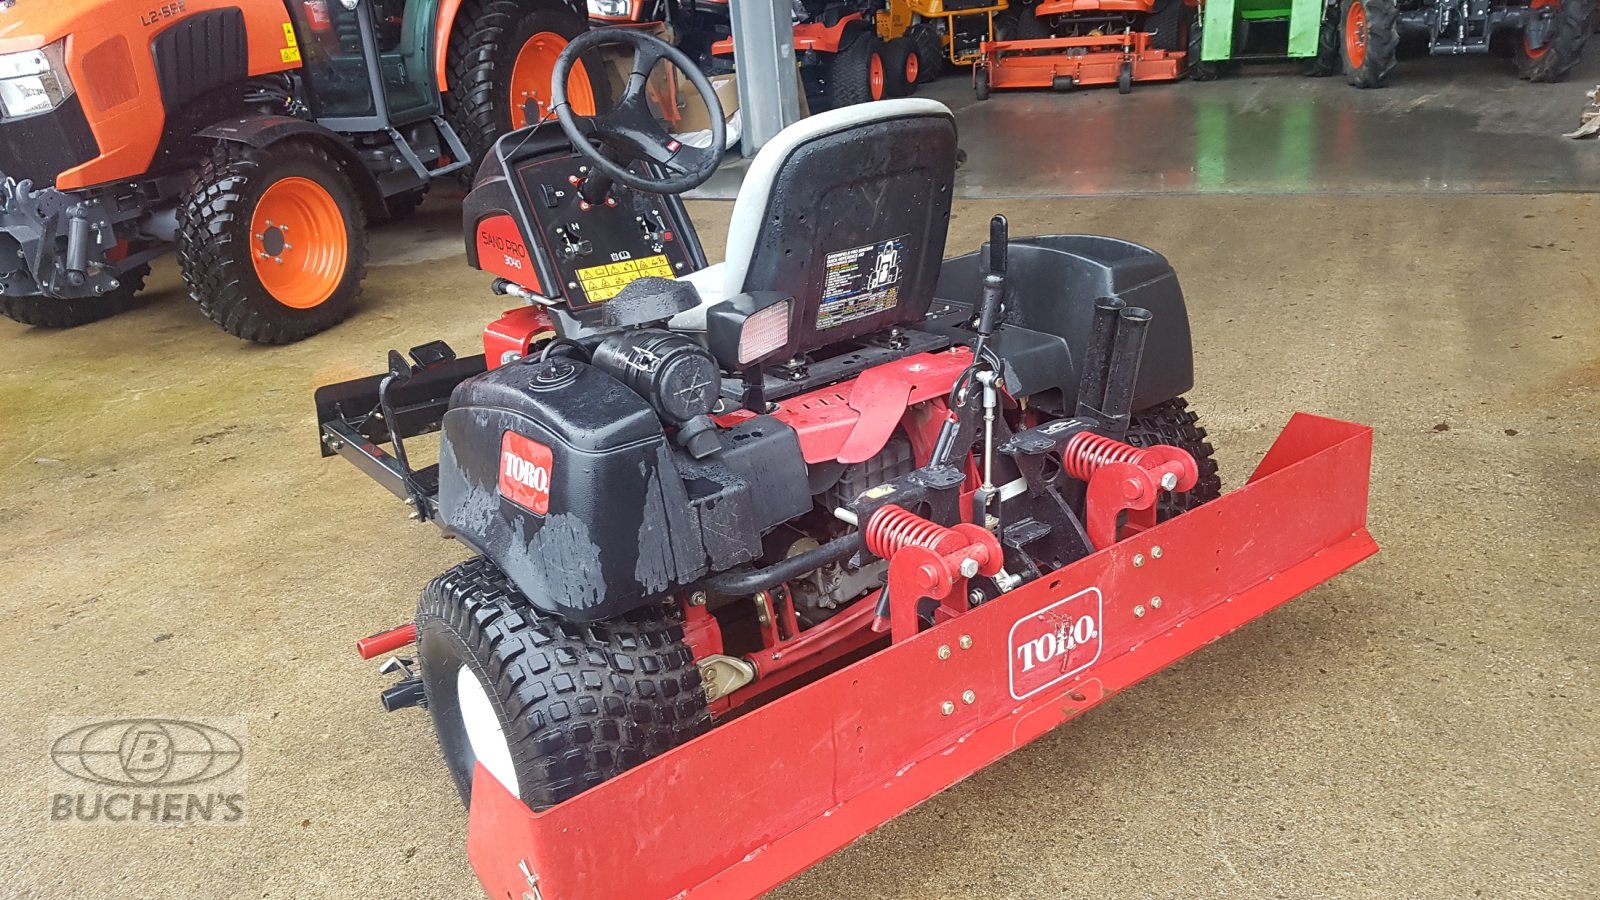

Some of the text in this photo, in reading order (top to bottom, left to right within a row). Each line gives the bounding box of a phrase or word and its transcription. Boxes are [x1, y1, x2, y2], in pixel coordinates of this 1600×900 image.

[481, 231, 526, 258] SAND PRO
[503, 254, 522, 269] 3040
